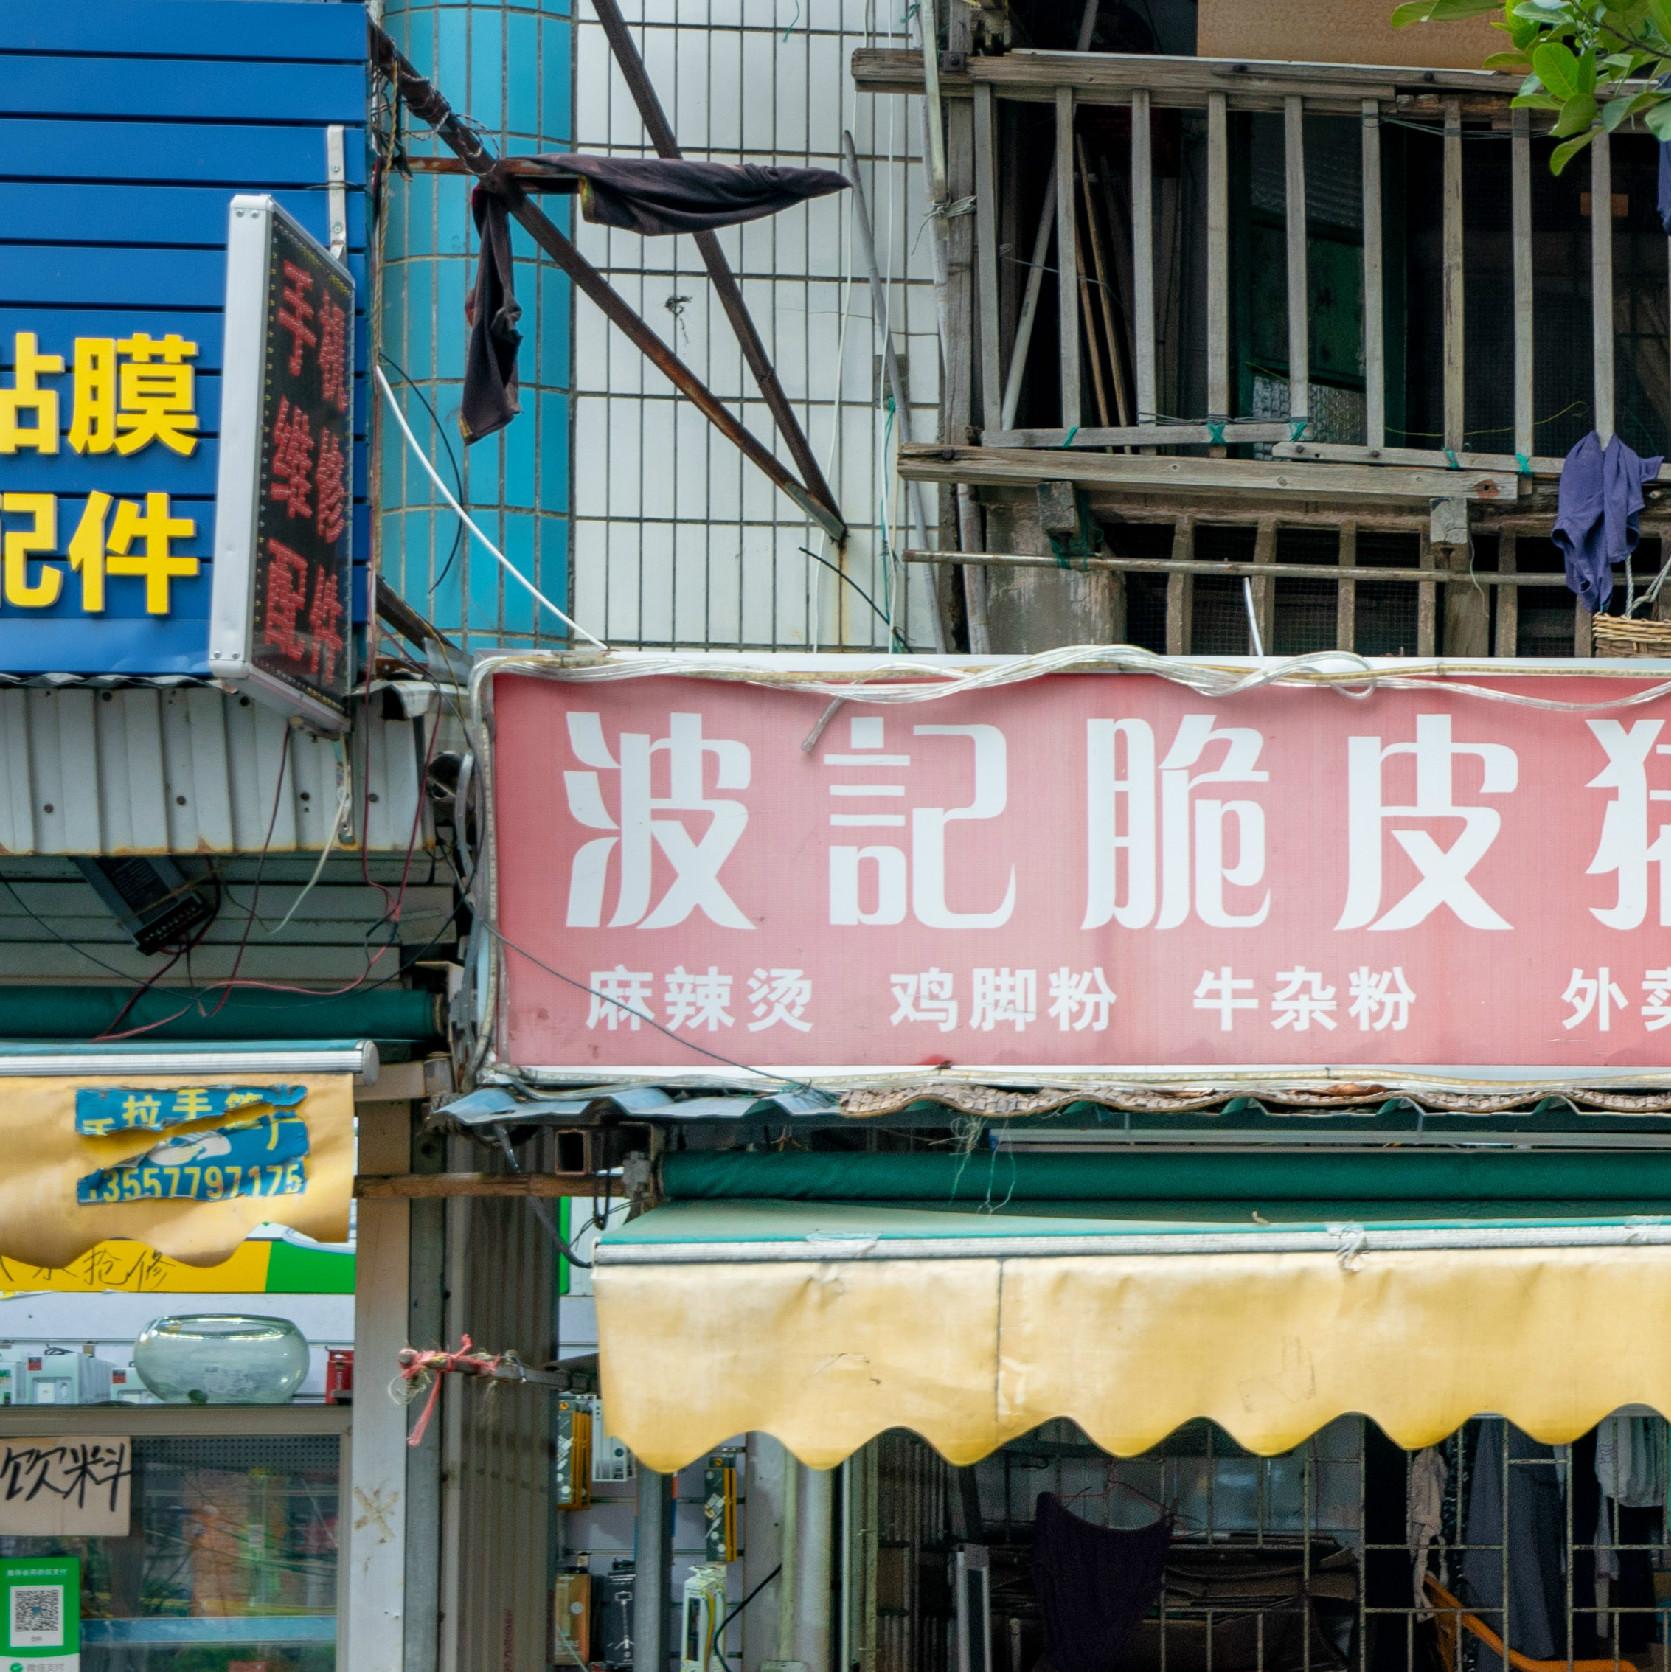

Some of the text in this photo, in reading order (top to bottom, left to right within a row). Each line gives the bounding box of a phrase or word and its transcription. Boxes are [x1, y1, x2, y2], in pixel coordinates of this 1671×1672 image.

[587, 966, 815, 1033] 麻辣烫
[890, 966, 1117, 1033] 鸡脚粉
[1192, 966, 1417, 1032] 牛杂粉
[89, 1167, 304, 1202] 3557797175
[0, 1443, 131, 1513] 饮料
